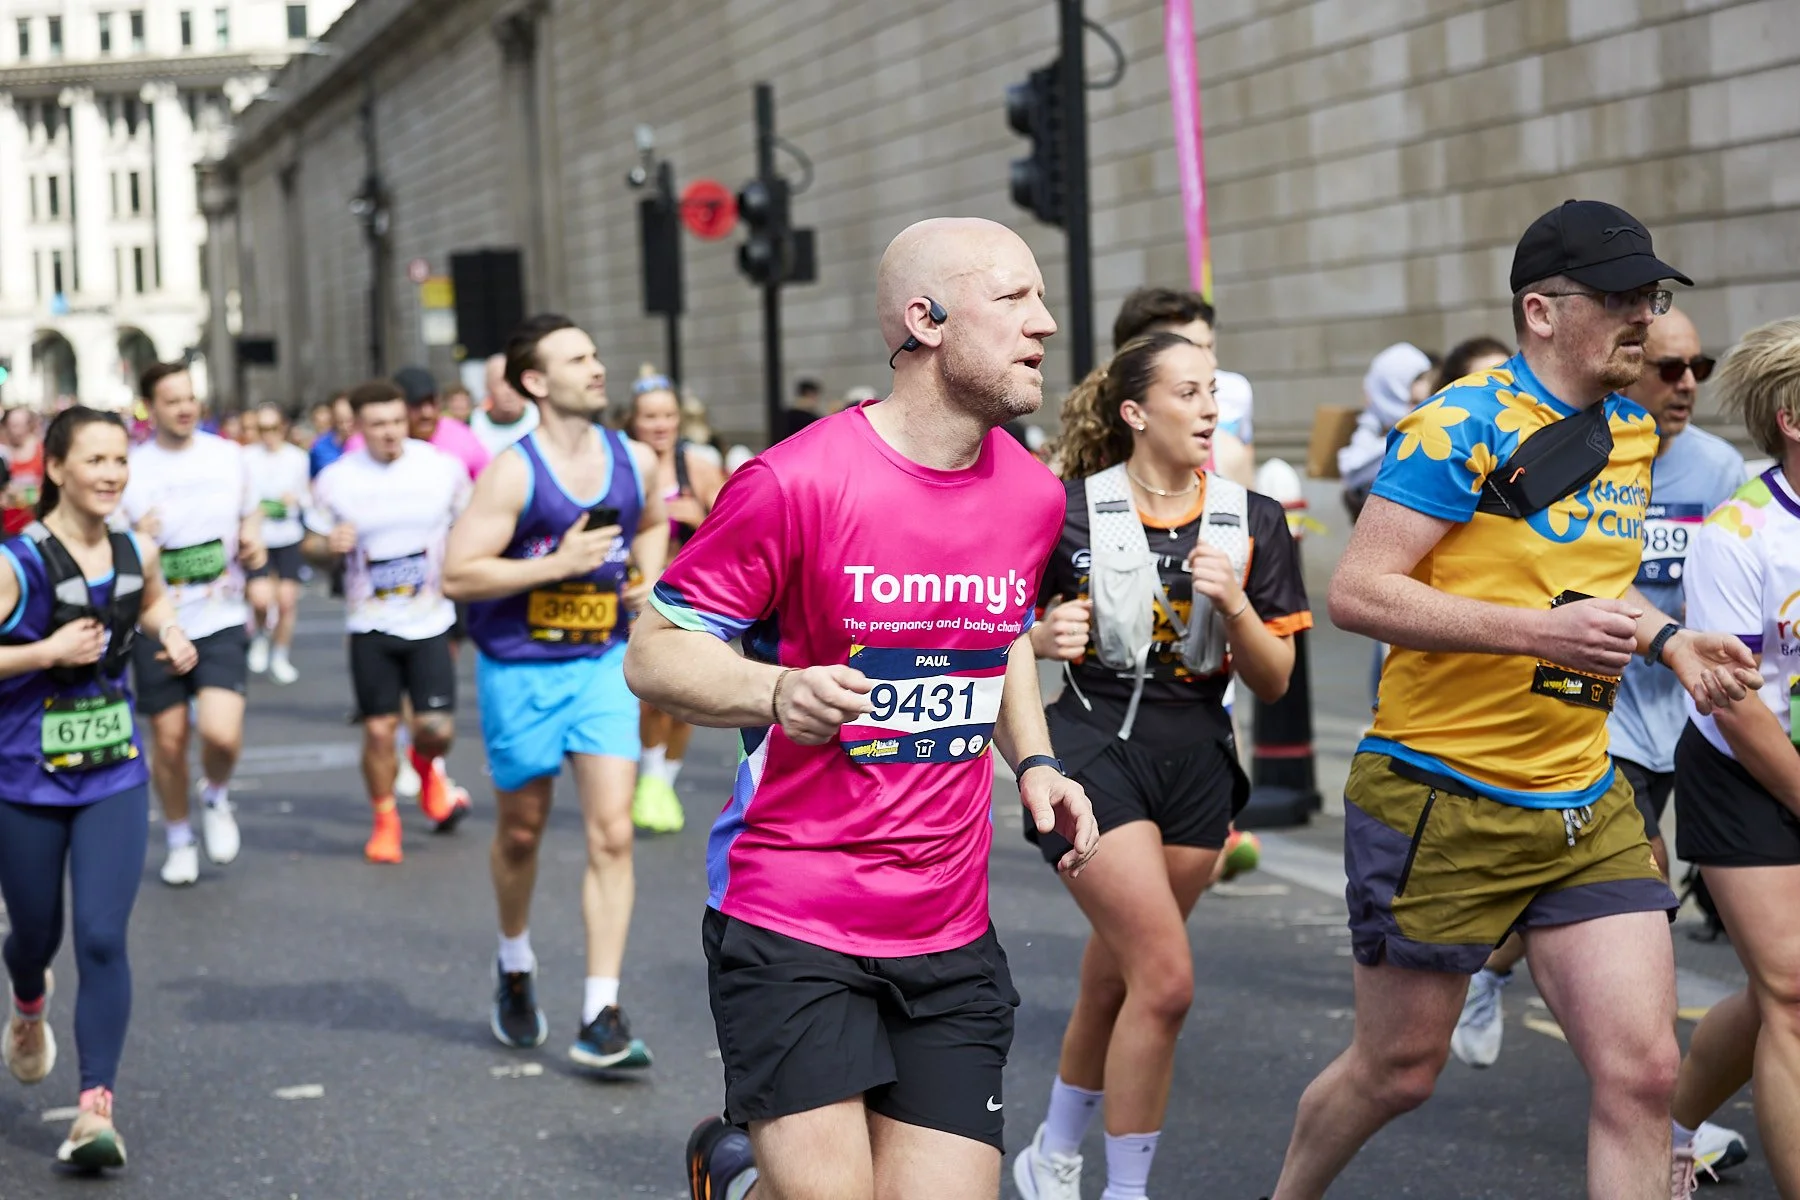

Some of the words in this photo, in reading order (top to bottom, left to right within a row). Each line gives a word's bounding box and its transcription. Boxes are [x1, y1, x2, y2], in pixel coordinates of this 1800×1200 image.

[843, 565, 1027, 615] Tommy's
[843, 618, 867, 630] The
[870, 619, 934, 633] pregnancy
[936, 617, 961, 629] and
[964, 618, 995, 634] baby
[915, 655, 951, 667] PAUL
[869, 682, 975, 722] 9431
[58, 713, 121, 743] 6754
